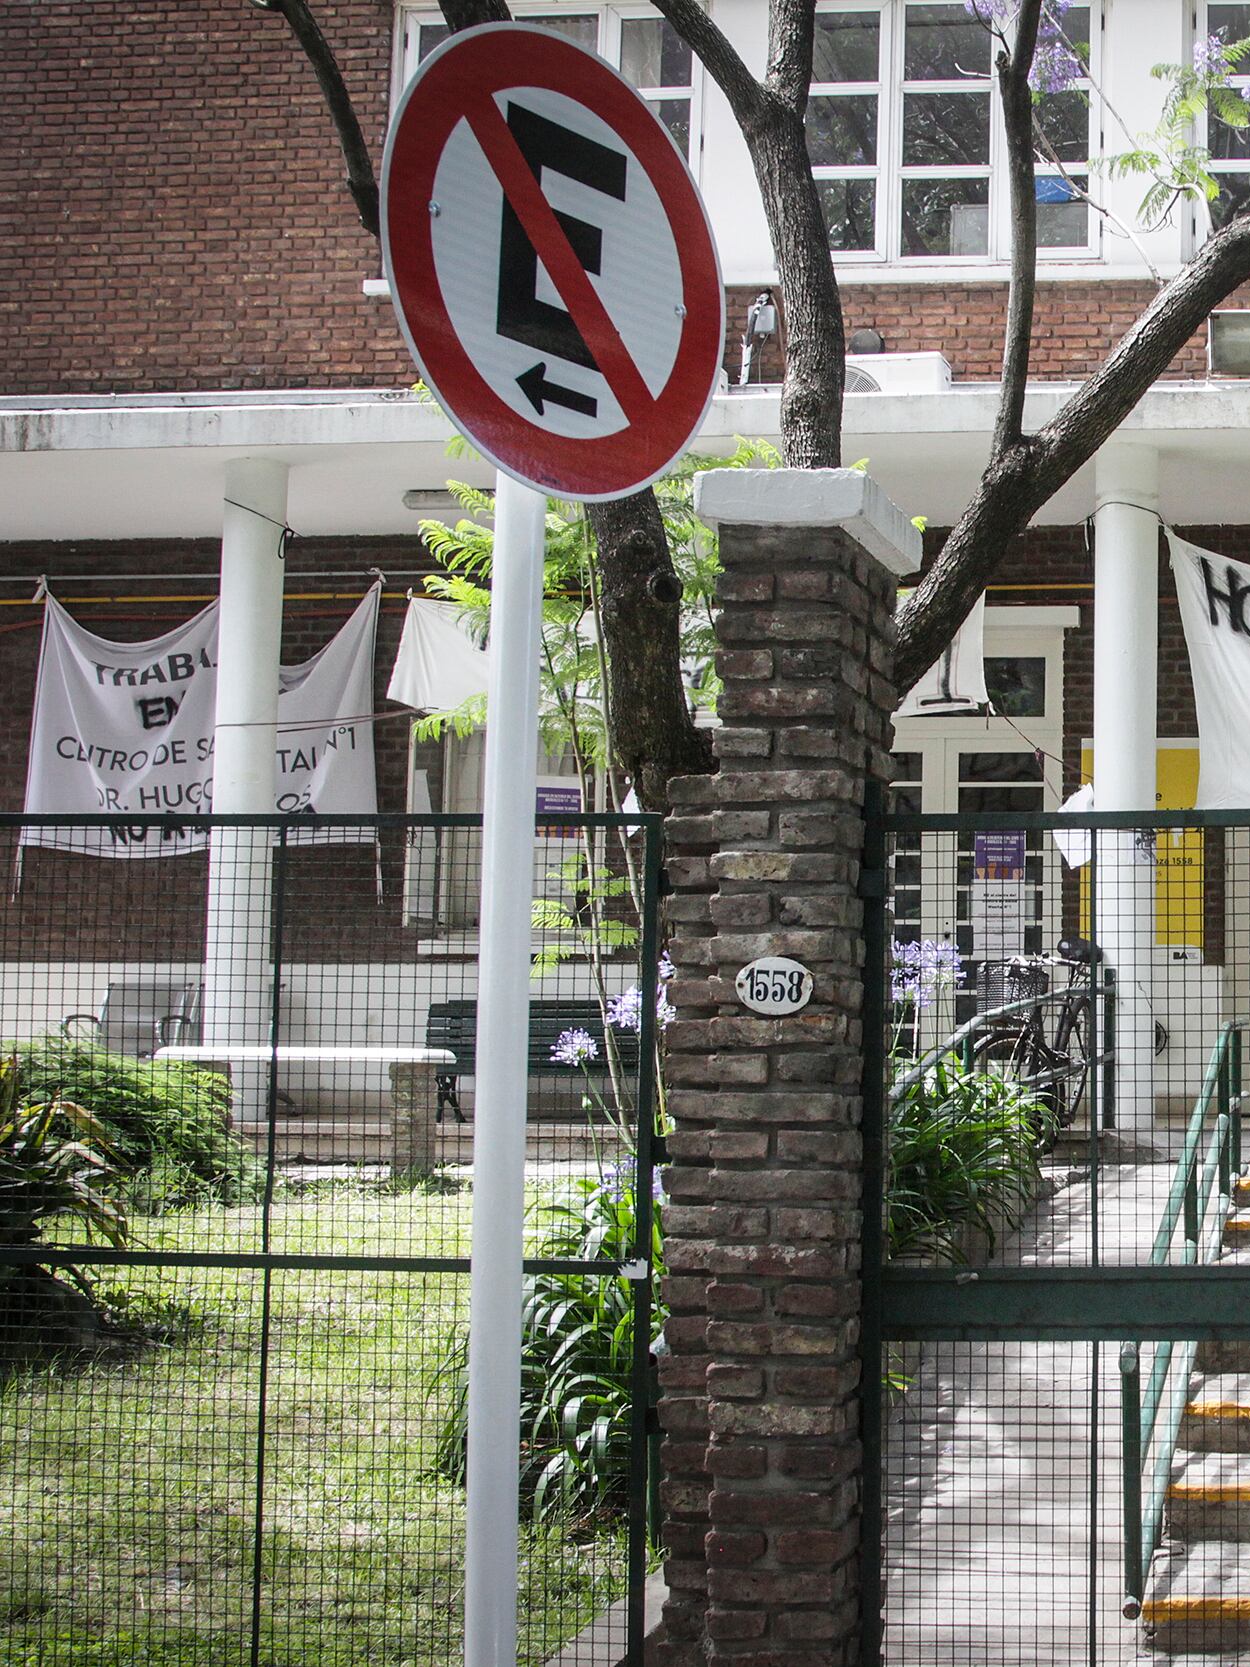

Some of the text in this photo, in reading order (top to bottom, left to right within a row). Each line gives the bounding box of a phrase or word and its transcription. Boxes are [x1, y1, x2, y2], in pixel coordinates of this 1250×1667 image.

[496, 101, 627, 373] E
[152, 740, 187, 766] DE
[1172, 857, 1193, 865] 1558
[1173, 951, 1188, 960] BA
[745, 967, 805, 1004] 1558
